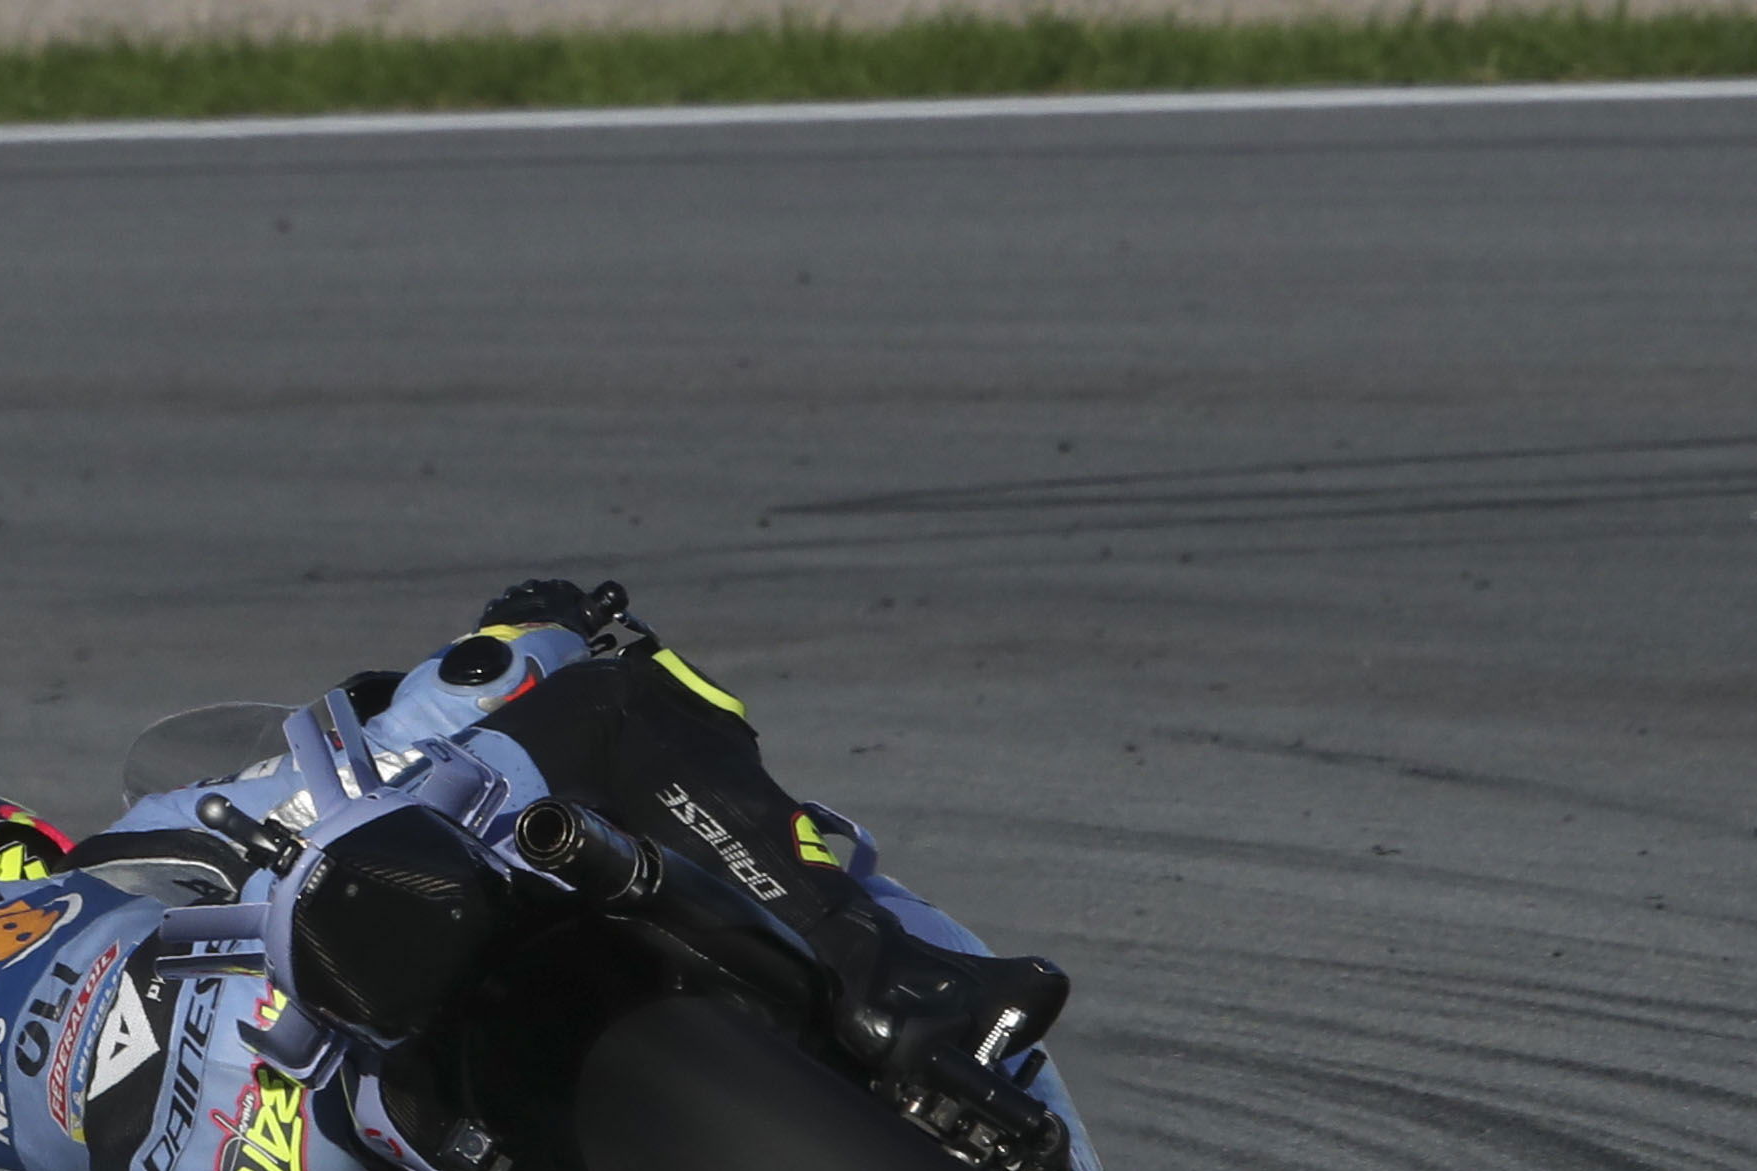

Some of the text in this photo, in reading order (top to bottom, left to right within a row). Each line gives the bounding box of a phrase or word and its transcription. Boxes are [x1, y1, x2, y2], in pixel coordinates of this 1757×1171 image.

[655, 783, 788, 901] DAINESE
[50, 954, 111, 1113] FEDERAL OIL
